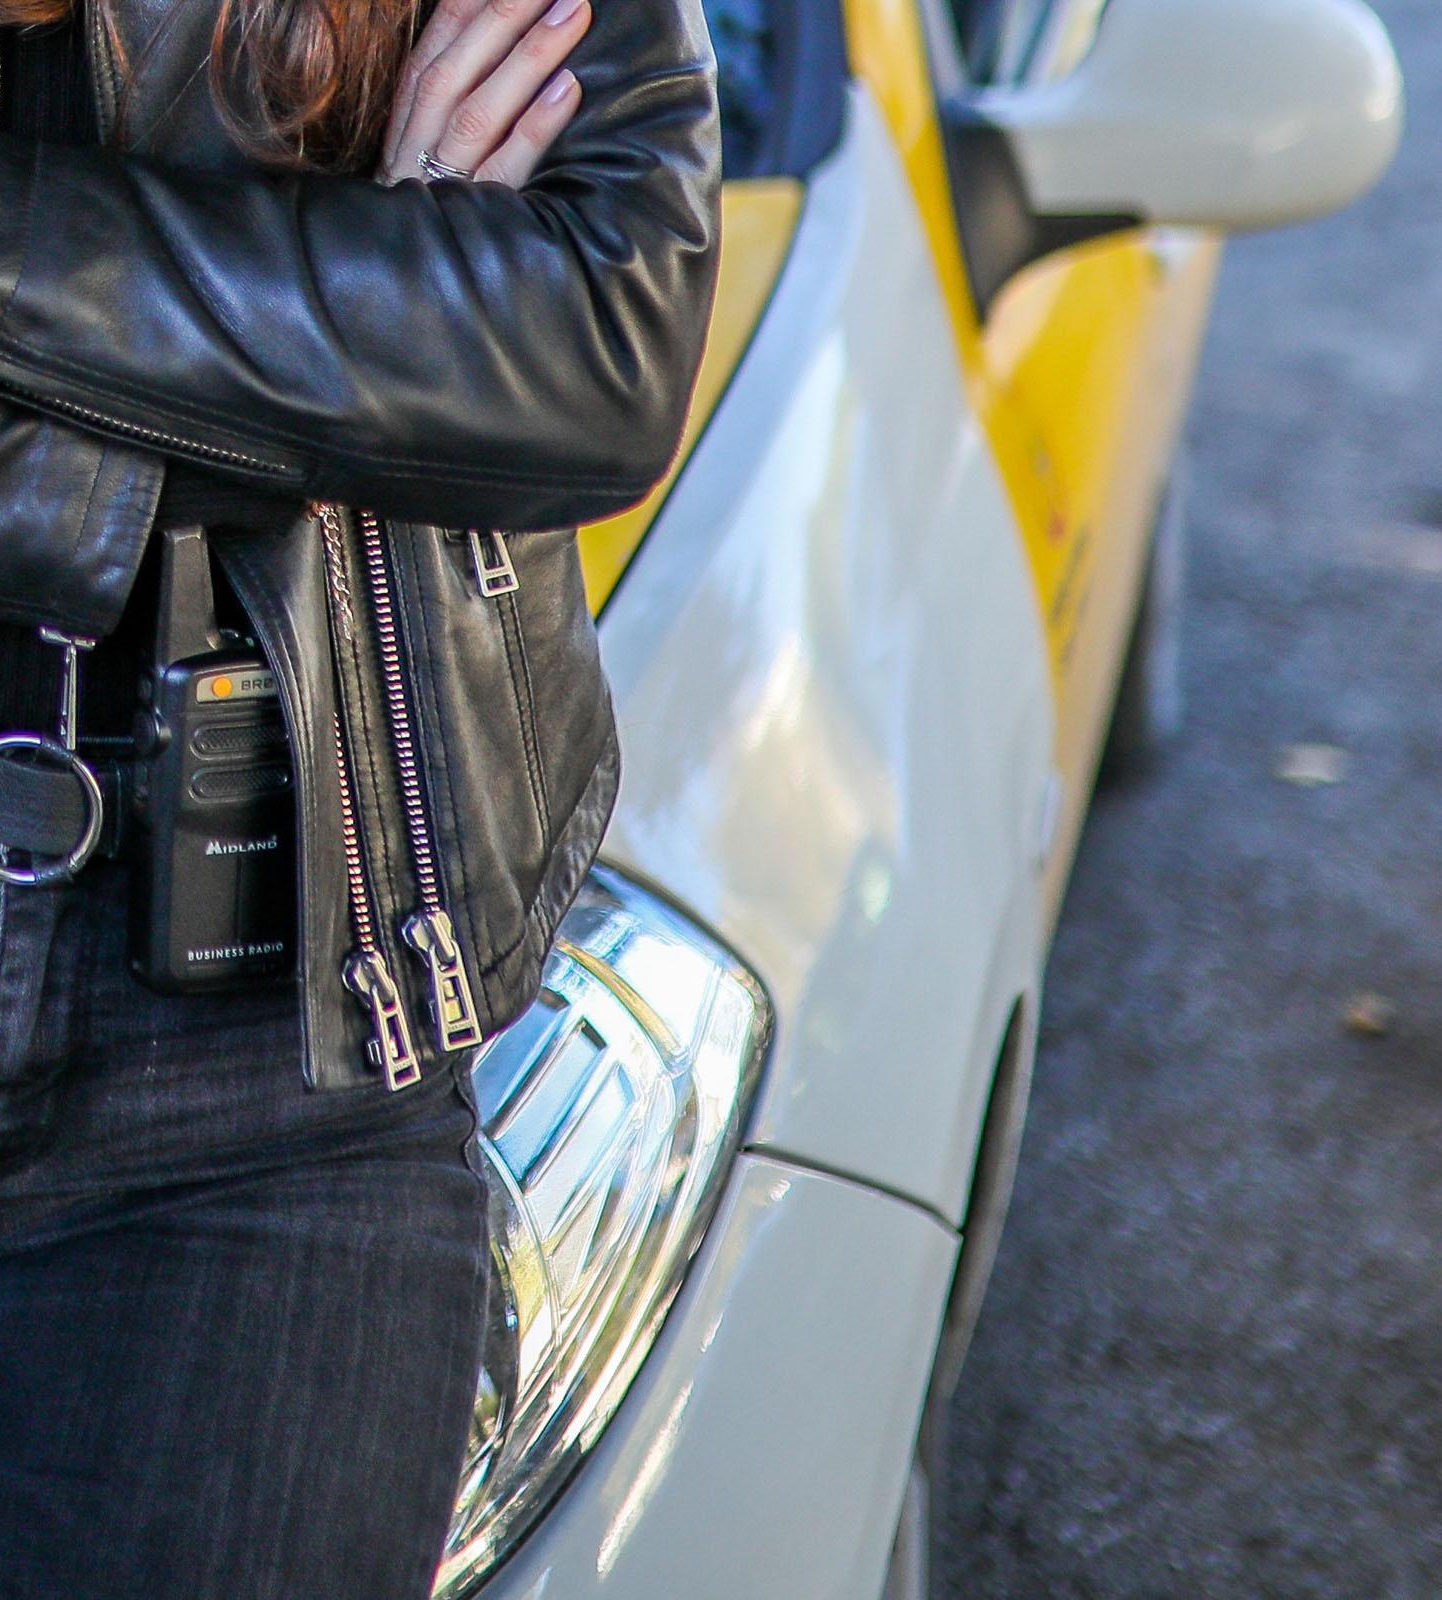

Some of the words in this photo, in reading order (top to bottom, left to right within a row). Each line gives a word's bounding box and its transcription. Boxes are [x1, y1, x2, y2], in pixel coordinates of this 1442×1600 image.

[205, 840, 278, 855] MIDLAND
[187, 947, 244, 961] BUSINESS
[248, 942, 284, 956] RADIO
